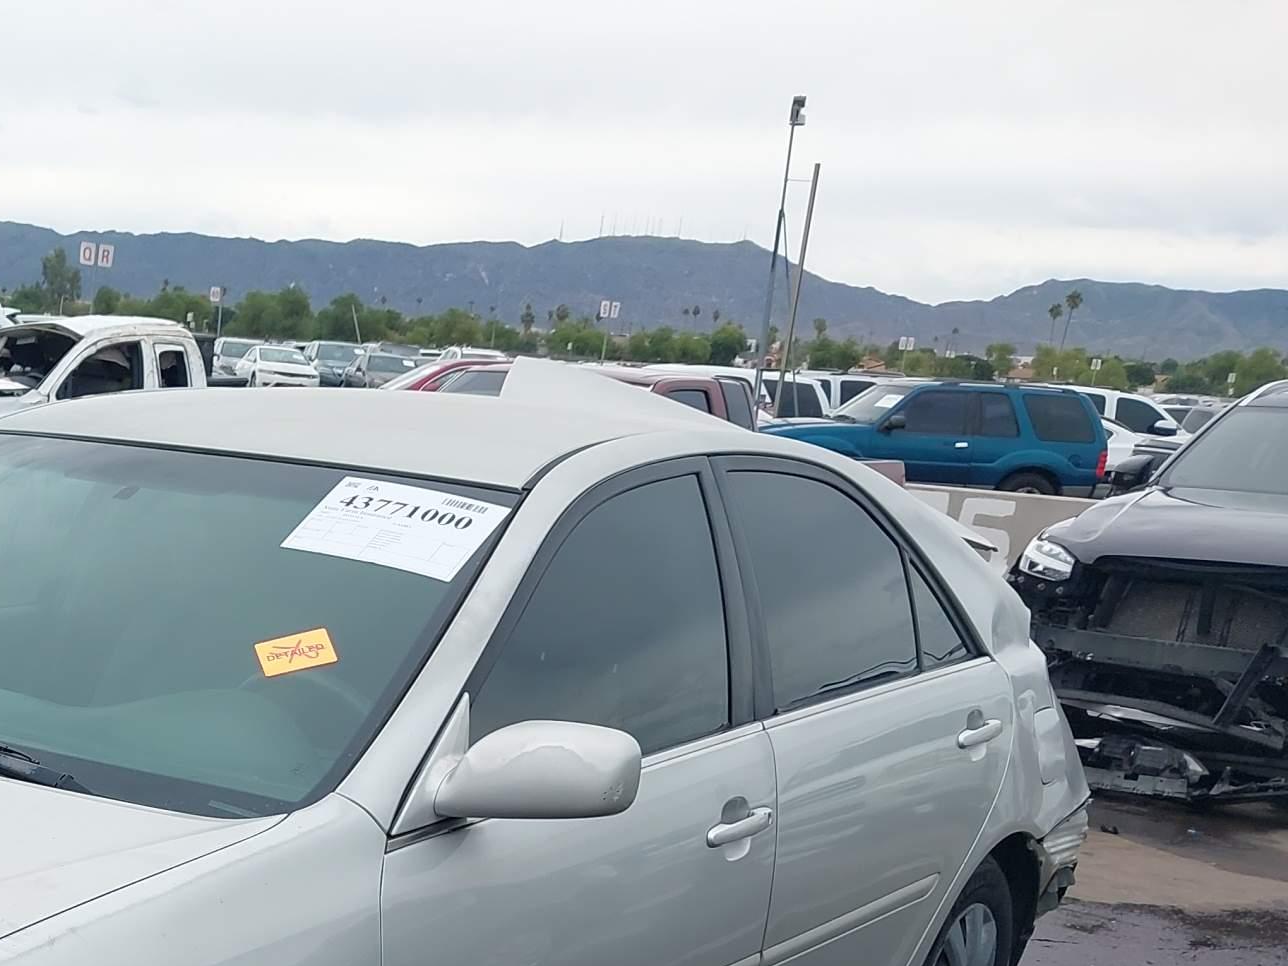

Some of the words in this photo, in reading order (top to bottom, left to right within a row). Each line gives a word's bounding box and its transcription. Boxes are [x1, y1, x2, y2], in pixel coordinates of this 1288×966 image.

[82, 246, 92, 262] Q
[101, 248, 110, 264] R
[339, 494, 473, 530] 43771000
[266, 643, 325, 662] DETAILED
